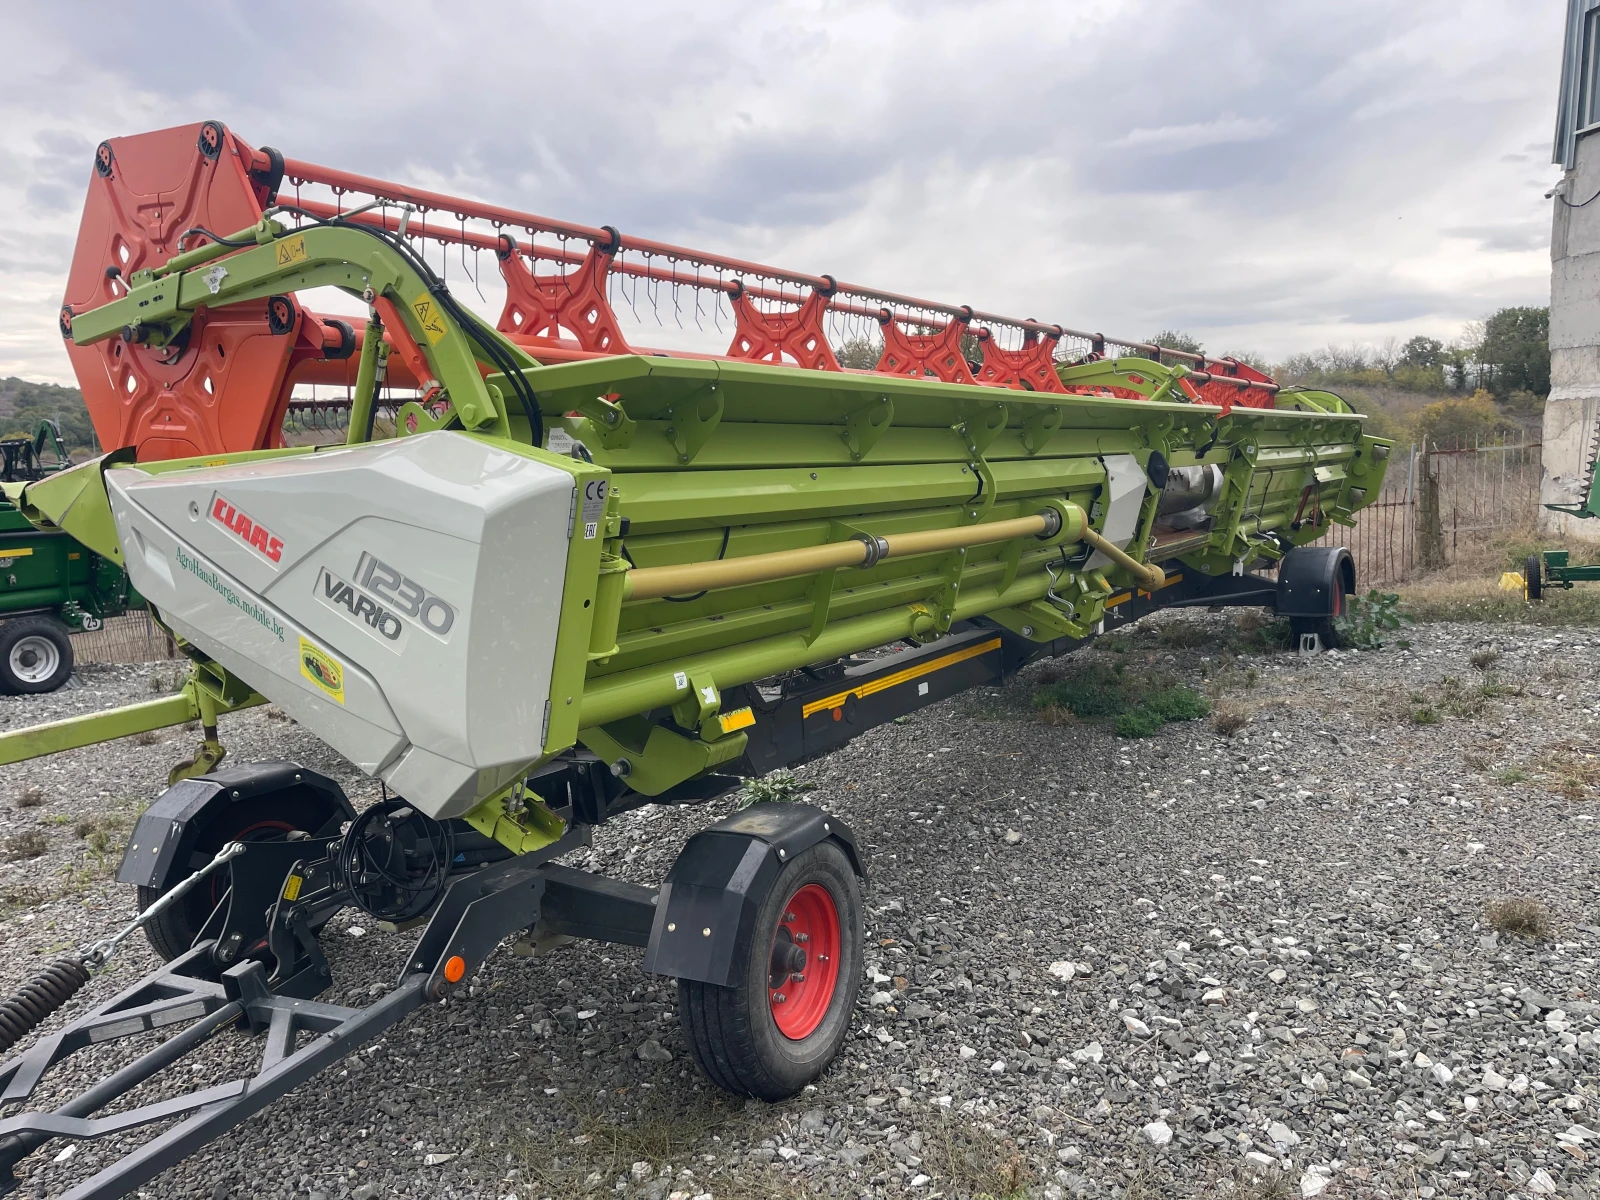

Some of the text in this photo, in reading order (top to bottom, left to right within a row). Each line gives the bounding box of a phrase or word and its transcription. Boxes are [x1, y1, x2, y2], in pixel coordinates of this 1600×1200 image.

[586, 481, 605, 500] CE
[212, 498, 284, 563] CLAAS
[86, 616, 98, 628] 25
[176, 546, 285, 642] AgroHausBurgas.mobile.bg
[325, 572, 402, 641] VARIO
[360, 556, 454, 636] 1230
